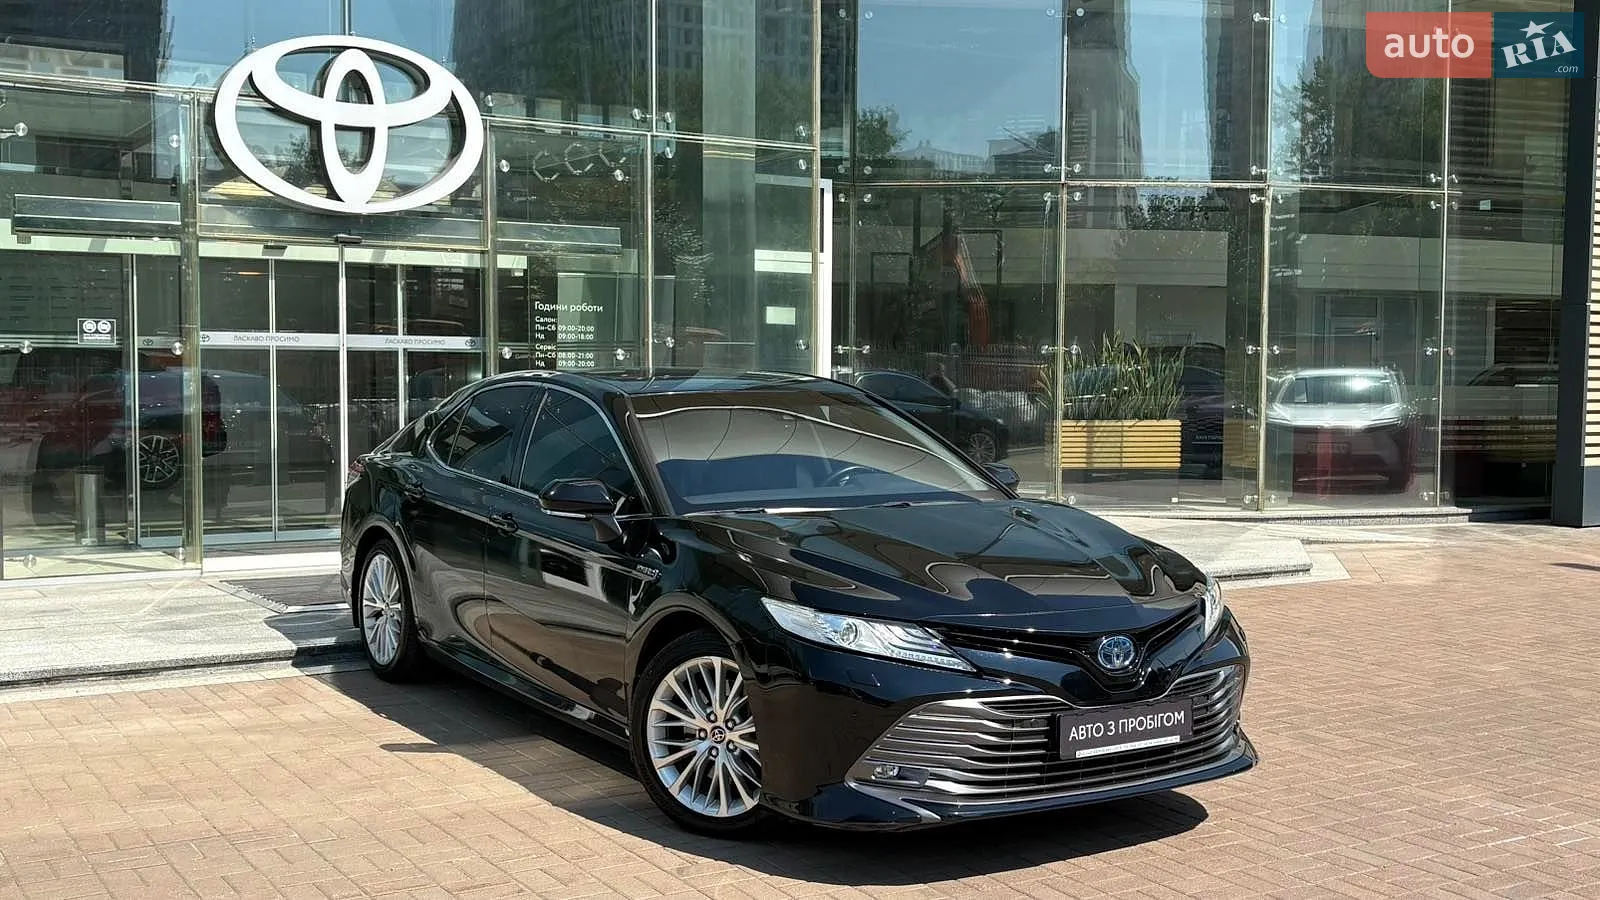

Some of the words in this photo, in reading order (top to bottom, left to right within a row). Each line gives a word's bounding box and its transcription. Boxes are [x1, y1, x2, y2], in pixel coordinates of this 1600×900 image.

[534, 301, 568, 312] Години
[570, 302, 604, 313] роботи
[1068, 722, 1104, 741] АВТО
[1107, 721, 1116, 736] З
[1119, 710, 1185, 734] ПРОБІГОМ
